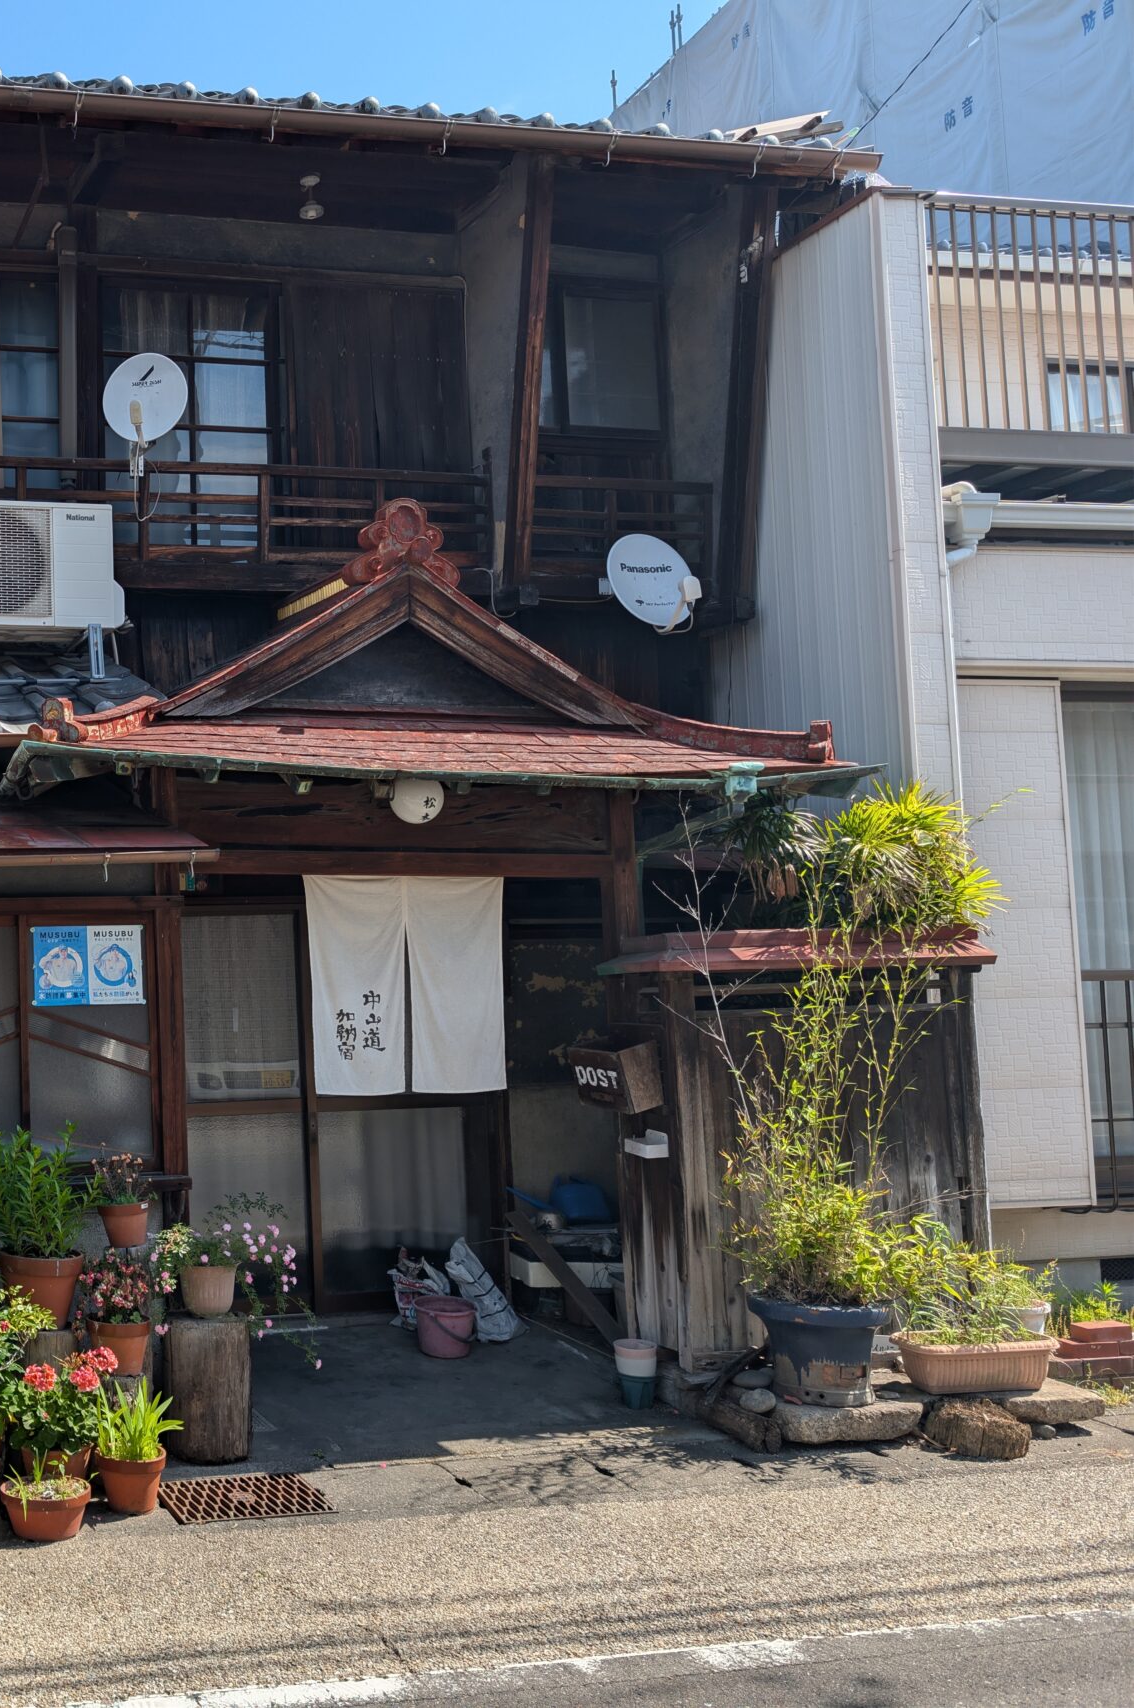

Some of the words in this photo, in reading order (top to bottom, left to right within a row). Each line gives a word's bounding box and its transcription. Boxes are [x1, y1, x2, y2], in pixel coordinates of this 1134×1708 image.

[944, 95, 973, 132] 防音
[620, 563, 673, 573] Panasonic
[40, 931, 80, 939] MUSUBU
[94, 930, 134, 938] MUSUBU
[362, 990, 386, 1051] 中山道
[336, 1009, 357, 1061] 加納宿
[575, 1065, 618, 1089] POST
